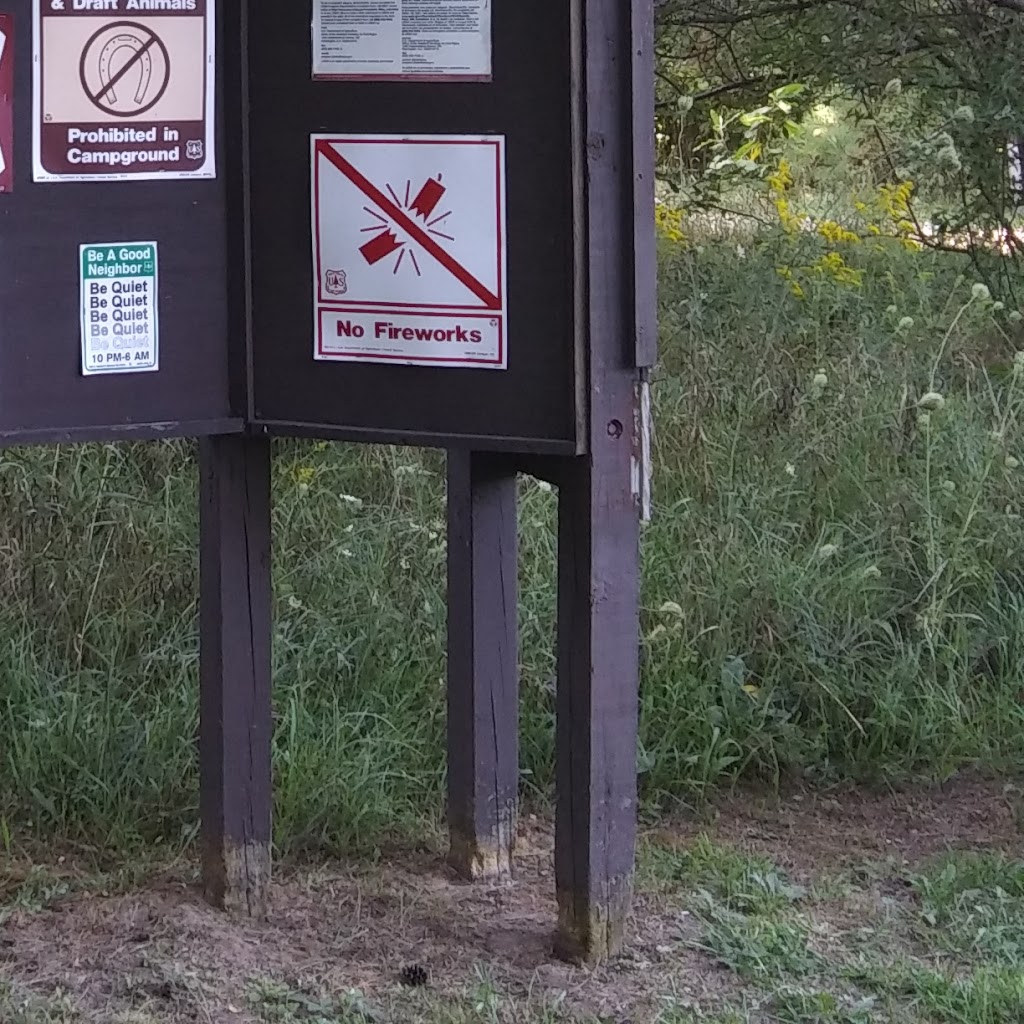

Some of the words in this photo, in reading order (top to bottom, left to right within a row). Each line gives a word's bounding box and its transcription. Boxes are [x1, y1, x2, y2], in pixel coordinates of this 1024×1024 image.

[68, 127, 157, 144] Prohibited
[164, 125, 179, 141] in
[67, 147, 180, 165] Campground
[87, 250, 104, 262] Be
[107, 251, 116, 261] A
[119, 248, 151, 260] Good
[88, 263, 142, 277] Neighbor
[90, 282, 107, 295] Be
[111, 280, 148, 294] Quiet
[90, 296, 108, 309] Be
[111, 294, 148, 308] Quiet
[90, 310, 108, 323] Be
[112, 308, 149, 322] Quiet
[90, 324, 109, 337] Be
[112, 321, 149, 336] Quiet
[336, 320, 364, 338] No
[374, 321, 482, 343] Fireworks
[92, 354, 103, 363] 10
[106, 353, 131, 362] PM-6
[134, 351, 150, 361] AM
